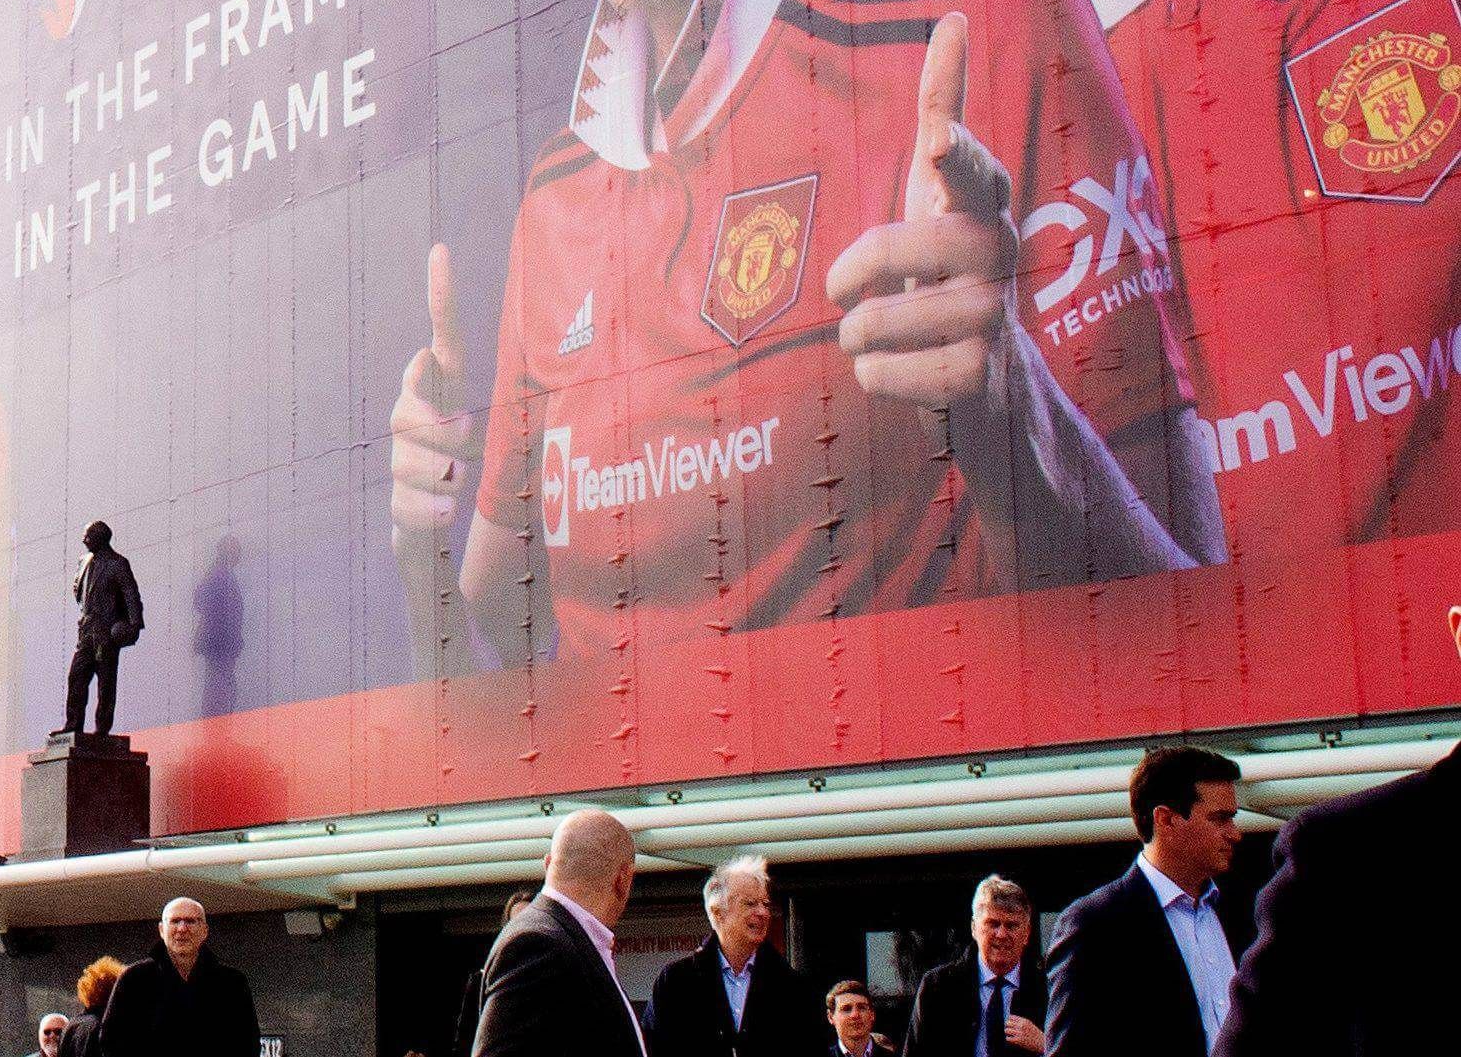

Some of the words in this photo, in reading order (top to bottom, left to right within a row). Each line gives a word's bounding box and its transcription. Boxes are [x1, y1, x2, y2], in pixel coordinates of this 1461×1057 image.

[5, 106, 44, 182] IN
[66, 42, 158, 145] THE
[1330, 40, 1439, 111] MANCHESTER
[13, 203, 54, 279] IN
[76, 144, 172, 246] THE
[198, 48, 377, 187] GAME
[1367, 118, 1444, 167] UNITED
[572, 416, 780, 512] TeamViewer
